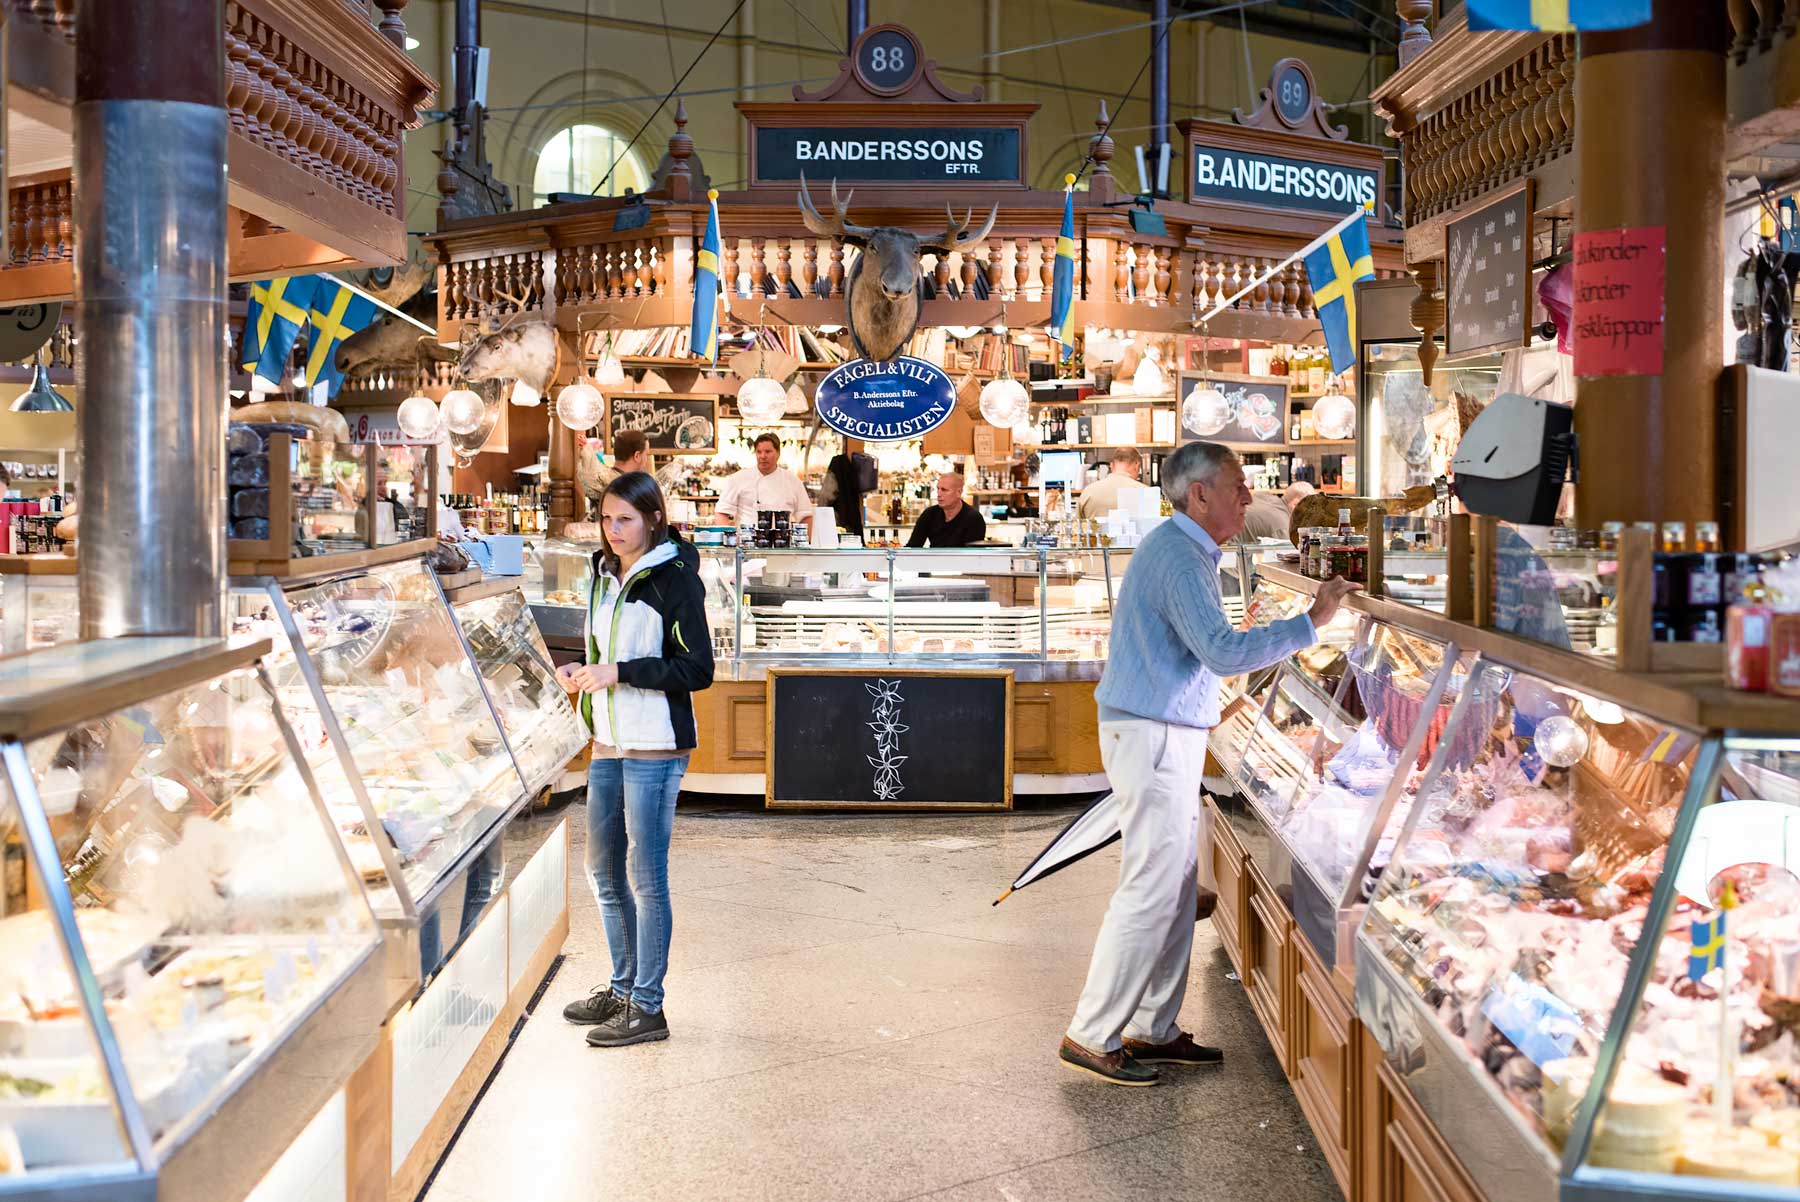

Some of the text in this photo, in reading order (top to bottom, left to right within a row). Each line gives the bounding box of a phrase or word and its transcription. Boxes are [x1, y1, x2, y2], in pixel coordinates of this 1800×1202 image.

[871, 46, 905, 72] 88
[1281, 80, 1302, 107] 89
[796, 139, 984, 162] B.ANDERSSONS
[945, 163, 981, 174] EFTR.
[1198, 153, 1376, 204] B.ANDERSSONS
[868, 400, 904, 409] Aktiebolag
[827, 401, 945, 437] SPECIALISTEN
